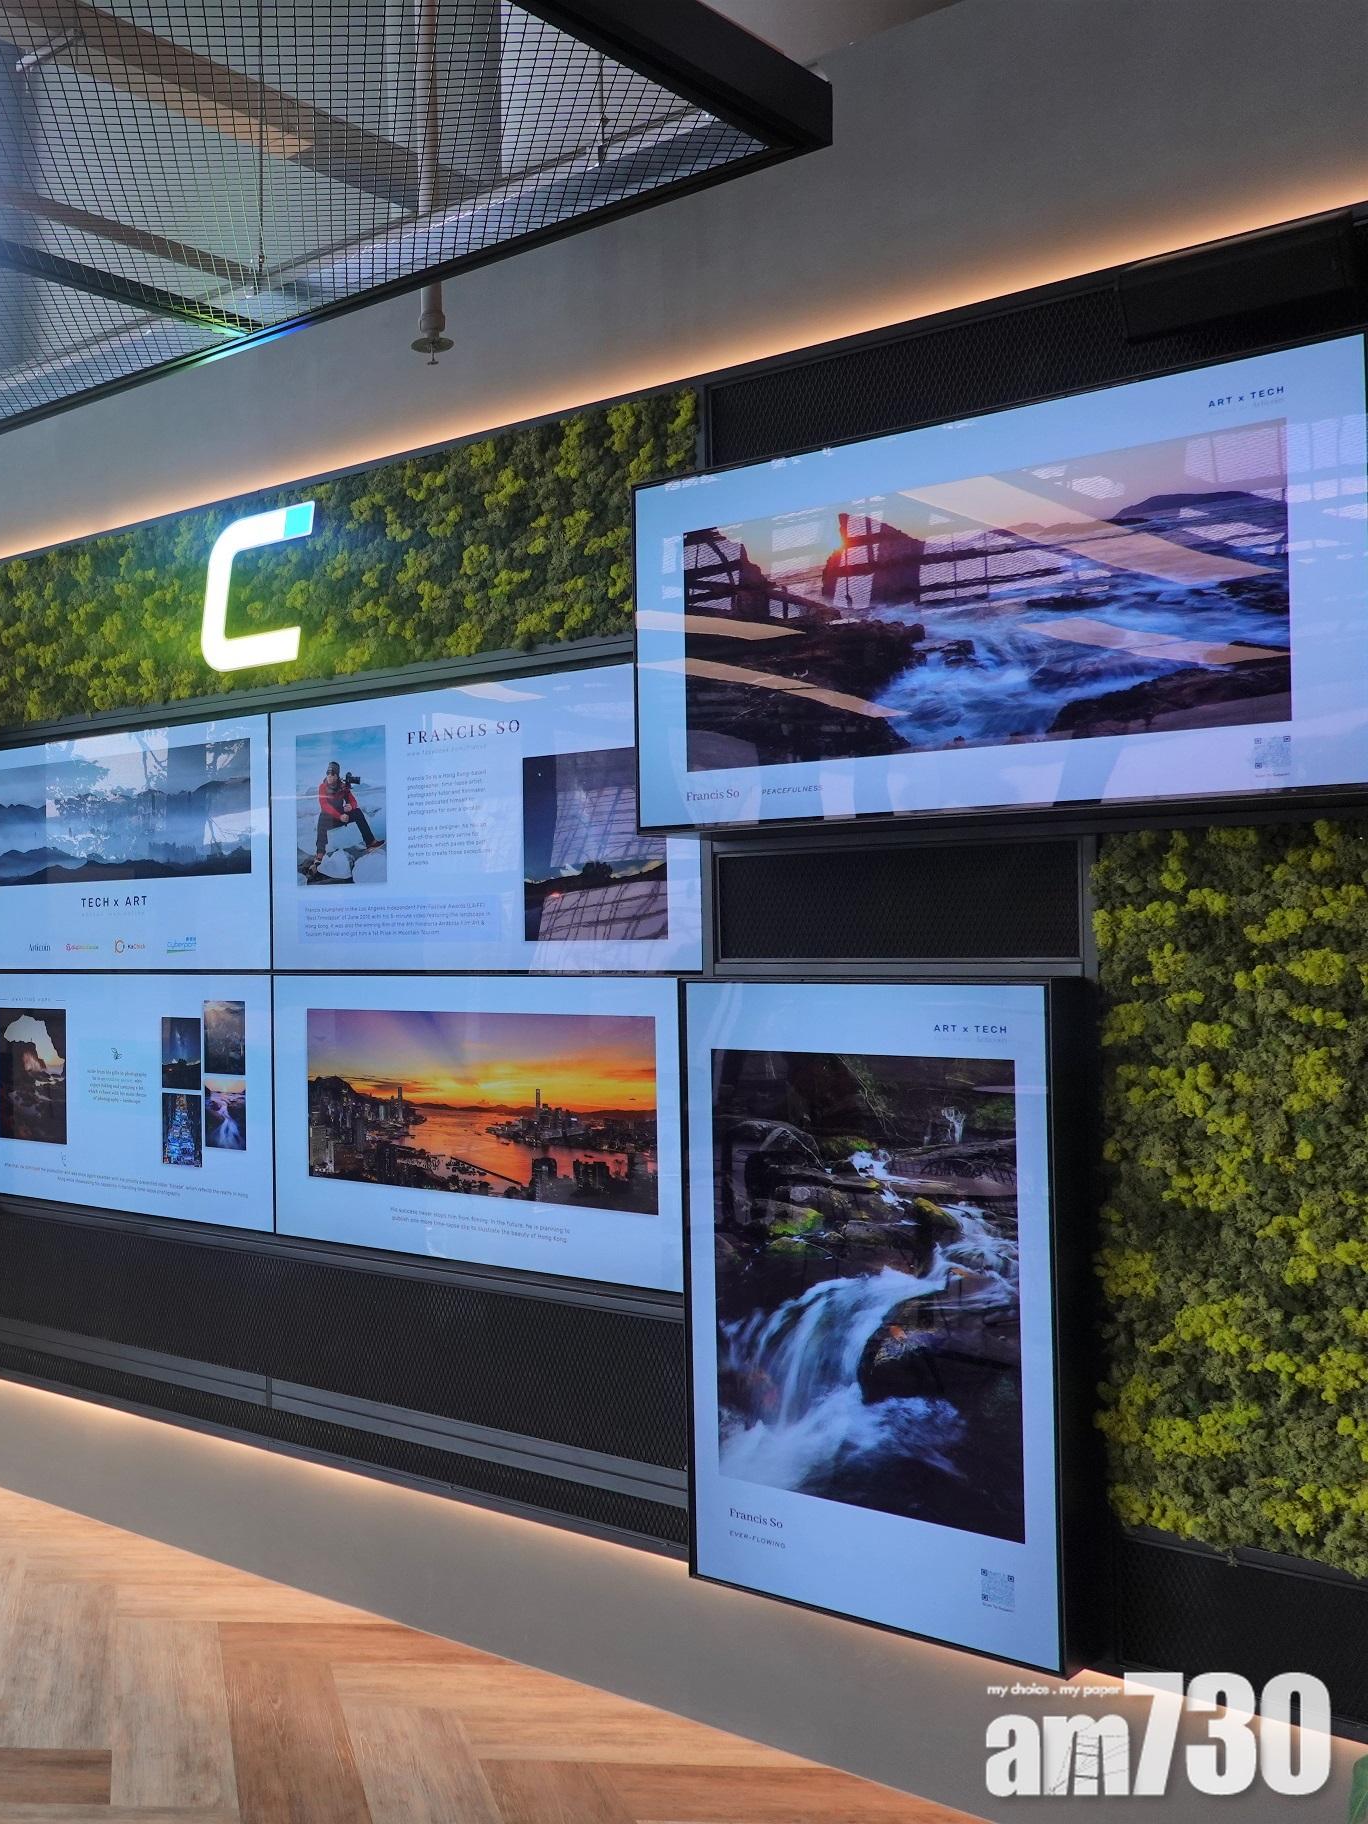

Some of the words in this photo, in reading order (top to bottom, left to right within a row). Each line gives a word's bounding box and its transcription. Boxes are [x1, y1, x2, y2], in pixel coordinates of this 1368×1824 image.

[1208, 396, 1232, 408] ART
[1250, 386, 1285, 400] TECH
[407, 723, 487, 745] FRANCIS
[495, 719, 520, 735] SO
[686, 789, 725, 801] Francis
[726, 788, 740, 799] So
[761, 785, 824, 796] PEACEFULNESS
[80, 896, 110, 908] TECH
[113, 898, 119, 907] x
[125, 895, 148, 907] ART
[933, 1024, 958, 1033] ART
[974, 1025, 1008, 1034] TECH
[539, 1225, 564, 1234] planning
[537, 1233, 552, 1242] Hong
[728, 1507, 768, 1526] Francis
[769, 1516, 783, 1529] So
[729, 1529, 786, 1550] EVER-FLOWING
